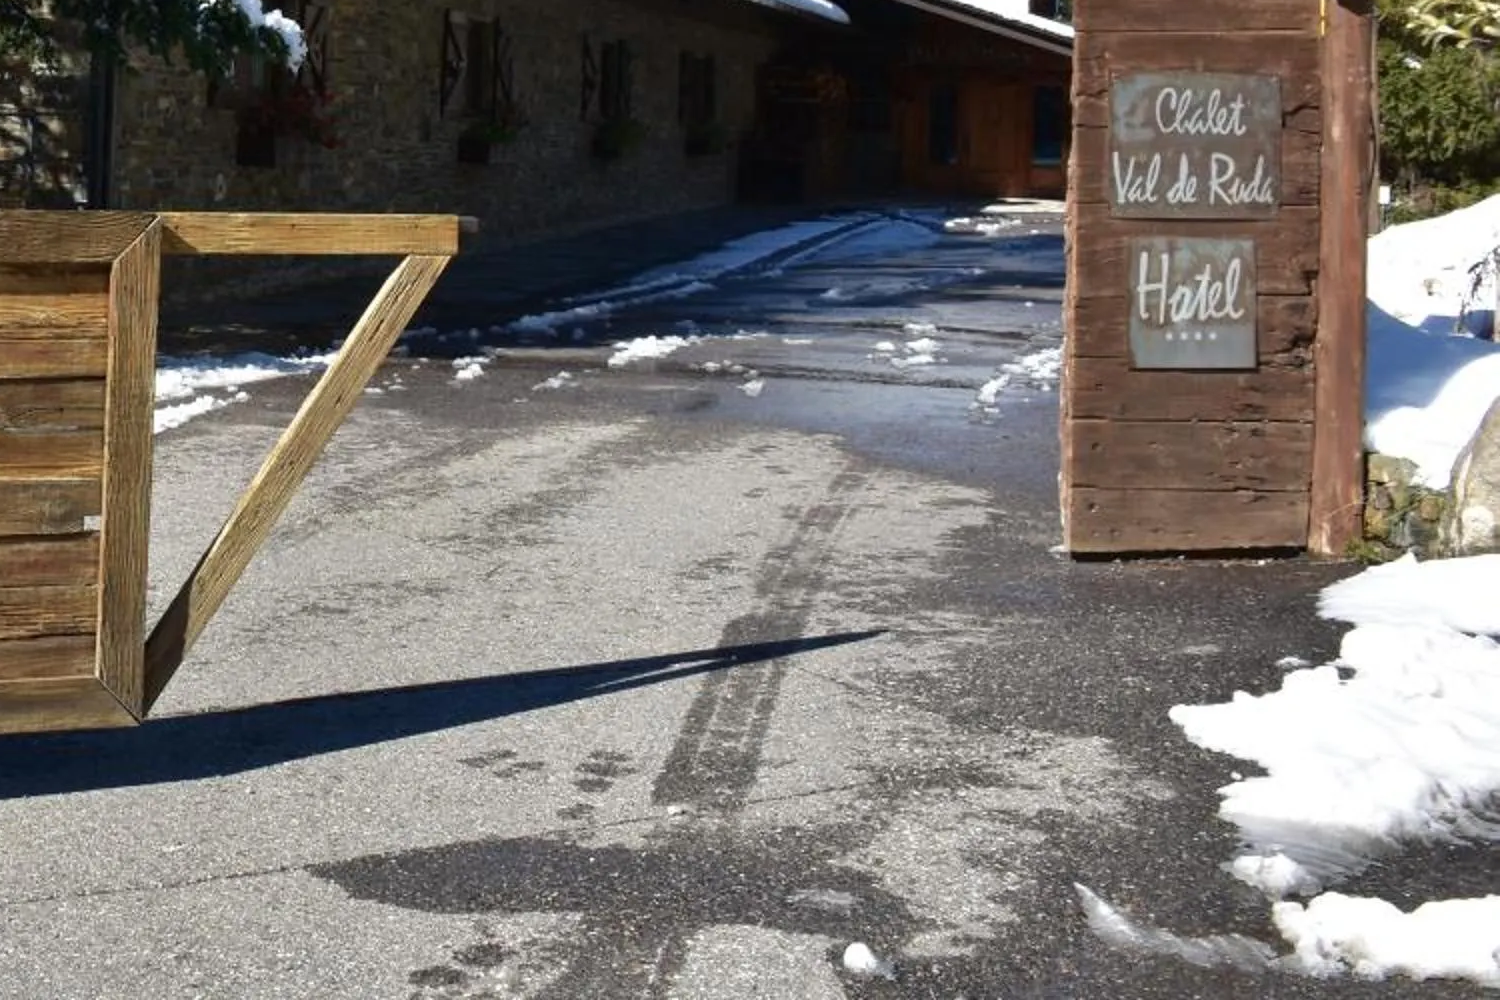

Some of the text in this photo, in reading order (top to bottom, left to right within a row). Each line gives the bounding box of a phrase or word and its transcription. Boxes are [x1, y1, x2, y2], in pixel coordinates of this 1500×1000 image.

[1155, 87, 1247, 136] Chalet
[1112, 151, 1274, 205] Val de Ruda
[1137, 251, 1246, 323] Hotel
